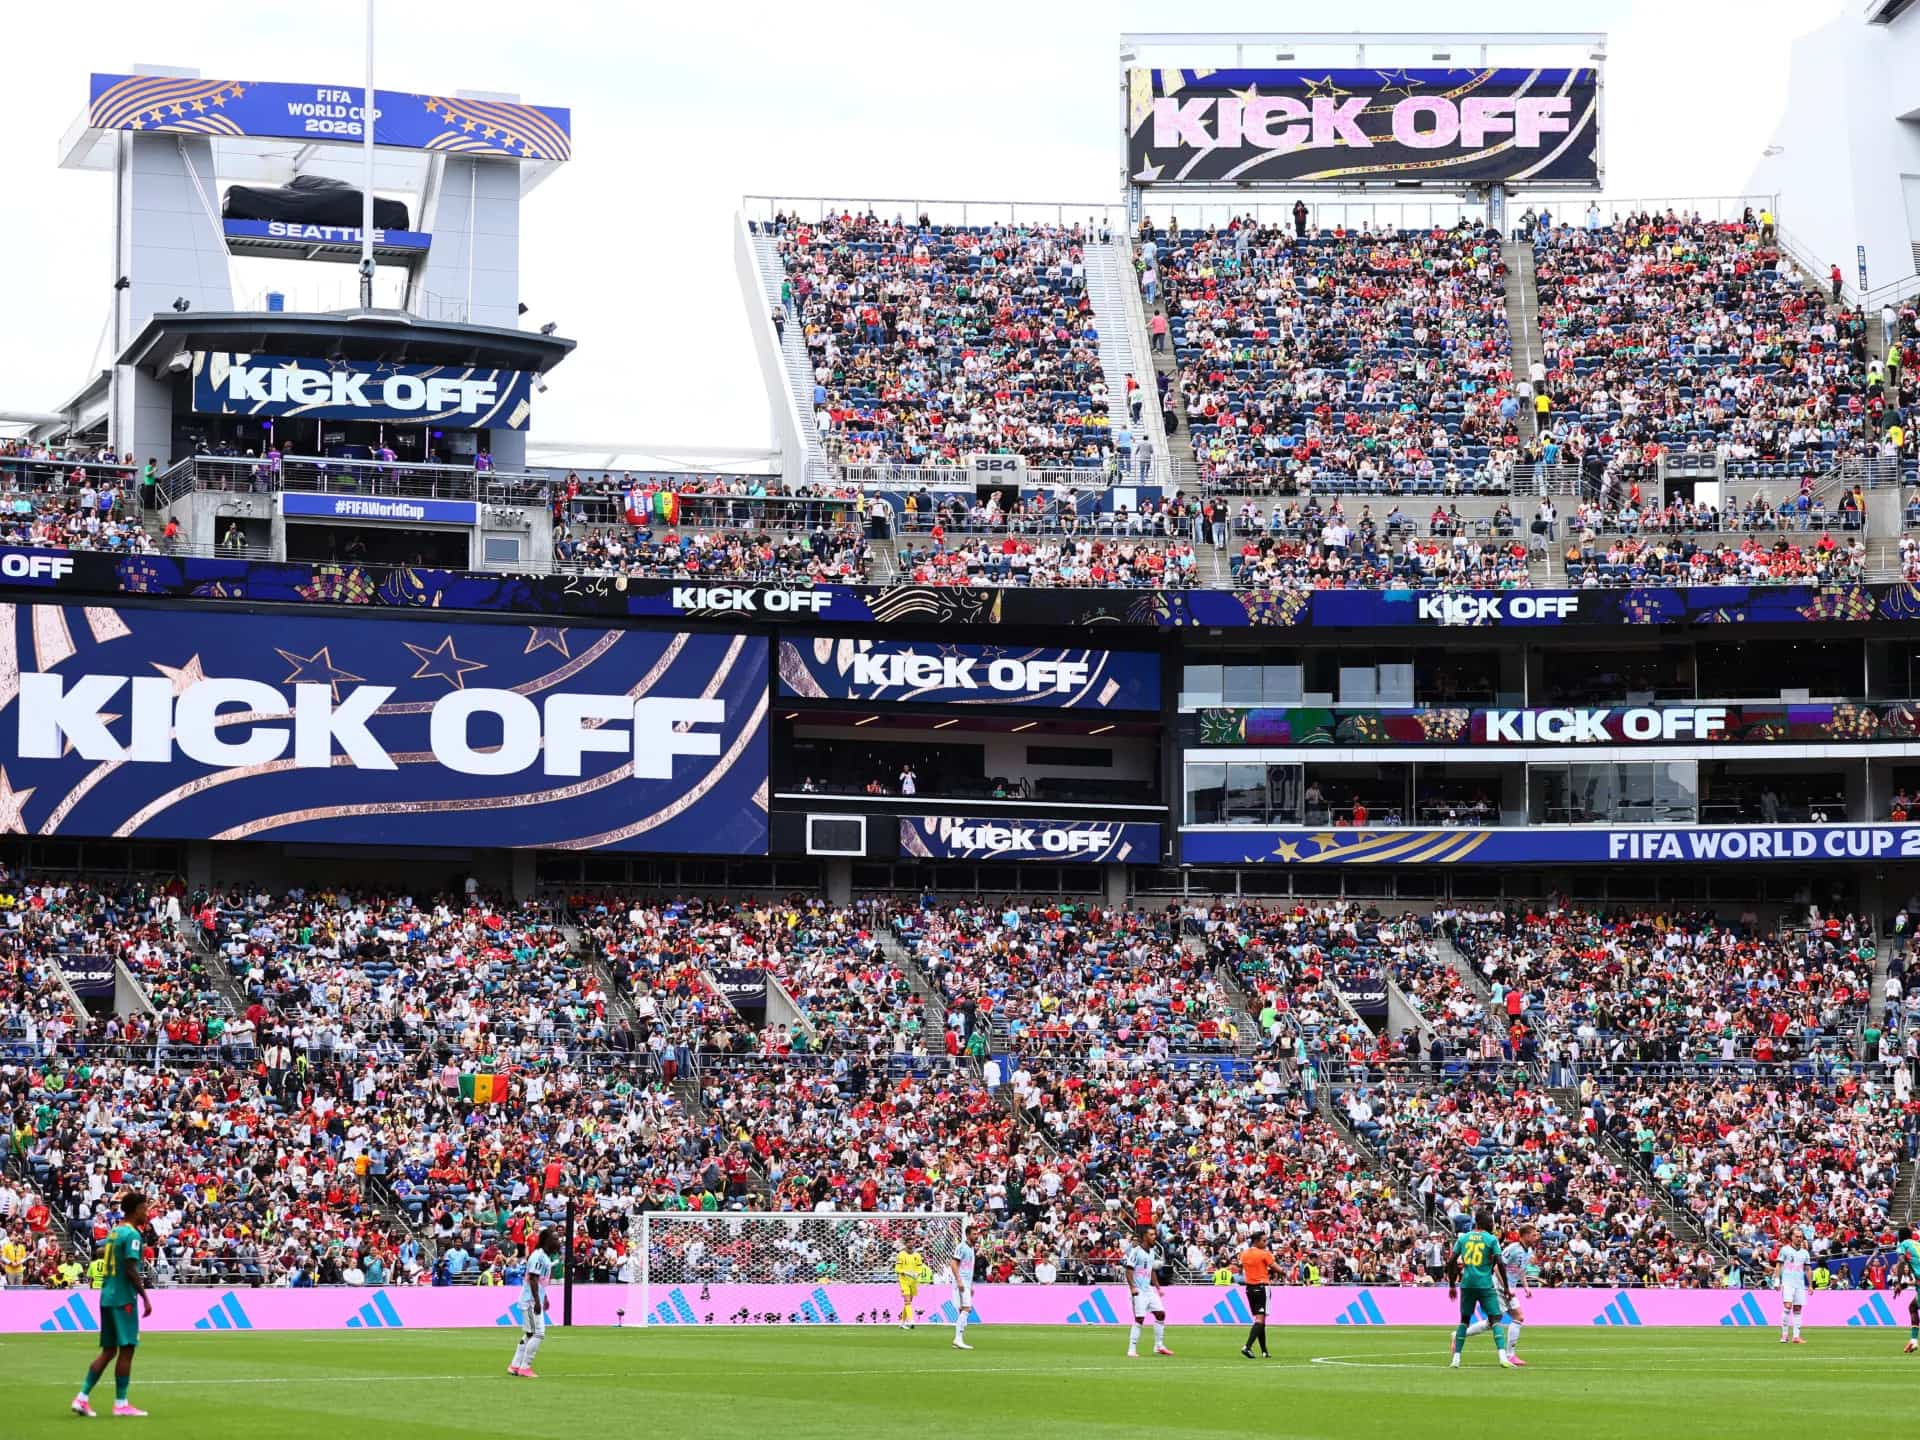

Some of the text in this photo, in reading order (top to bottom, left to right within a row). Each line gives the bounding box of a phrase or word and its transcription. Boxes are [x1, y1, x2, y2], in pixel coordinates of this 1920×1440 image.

[316, 89, 352, 104] FIFA
[287, 102, 347, 119] WORLD
[1153, 96, 1572, 149] KICK OFF
[305, 119, 363, 136] 2026
[268, 221, 385, 243] SEATTLE
[229, 365, 497, 413] KICK OFF
[975, 459, 1017, 471] 324
[1666, 455, 1717, 469] 326
[335, 500, 425, 520] #FIFAWorldCup
[2, 554, 74, 579] OFF
[672, 587, 833, 613] KICK OFF
[1418, 597, 1580, 620] KICK OFF
[853, 653, 1089, 694] KICK OFF
[18, 672, 726, 780] KICK OFF
[1485, 708, 1727, 741] KICK OFF
[951, 827, 1112, 853] KICK OFF
[1609, 832, 1683, 859] FIFA
[1689, 831, 1817, 858] WORLD
[1823, 830, 1894, 856] CUP
[1463, 1241, 1485, 1266] 26
